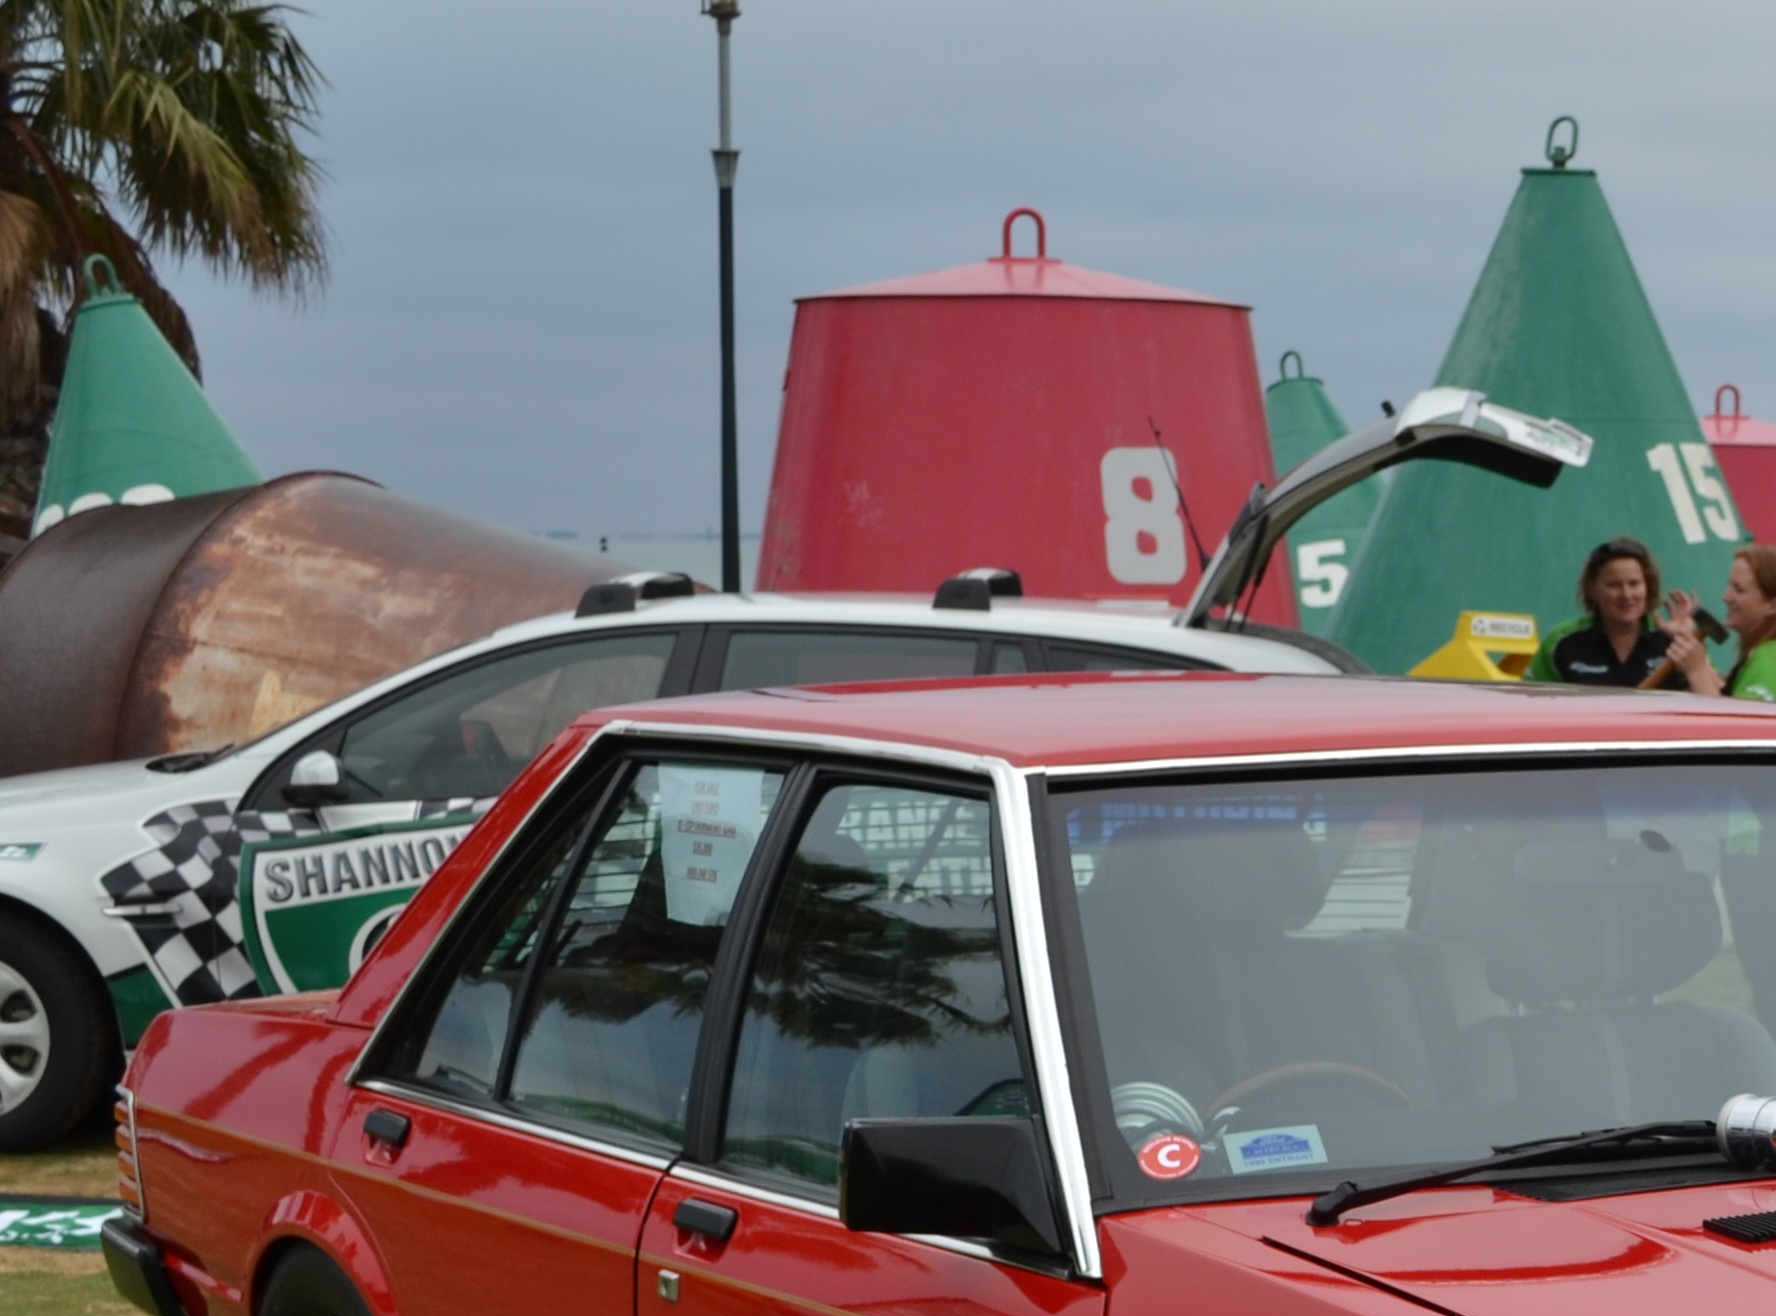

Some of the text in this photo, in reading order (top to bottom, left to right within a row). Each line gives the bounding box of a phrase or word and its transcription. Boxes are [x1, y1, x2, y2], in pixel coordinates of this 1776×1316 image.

[1100, 446, 1187, 585] 8
[1645, 442, 1740, 544] 15
[1297, 539, 1349, 608] 5
[264, 830, 471, 903] SHANNO
[1157, 1143, 1181, 1168] C
